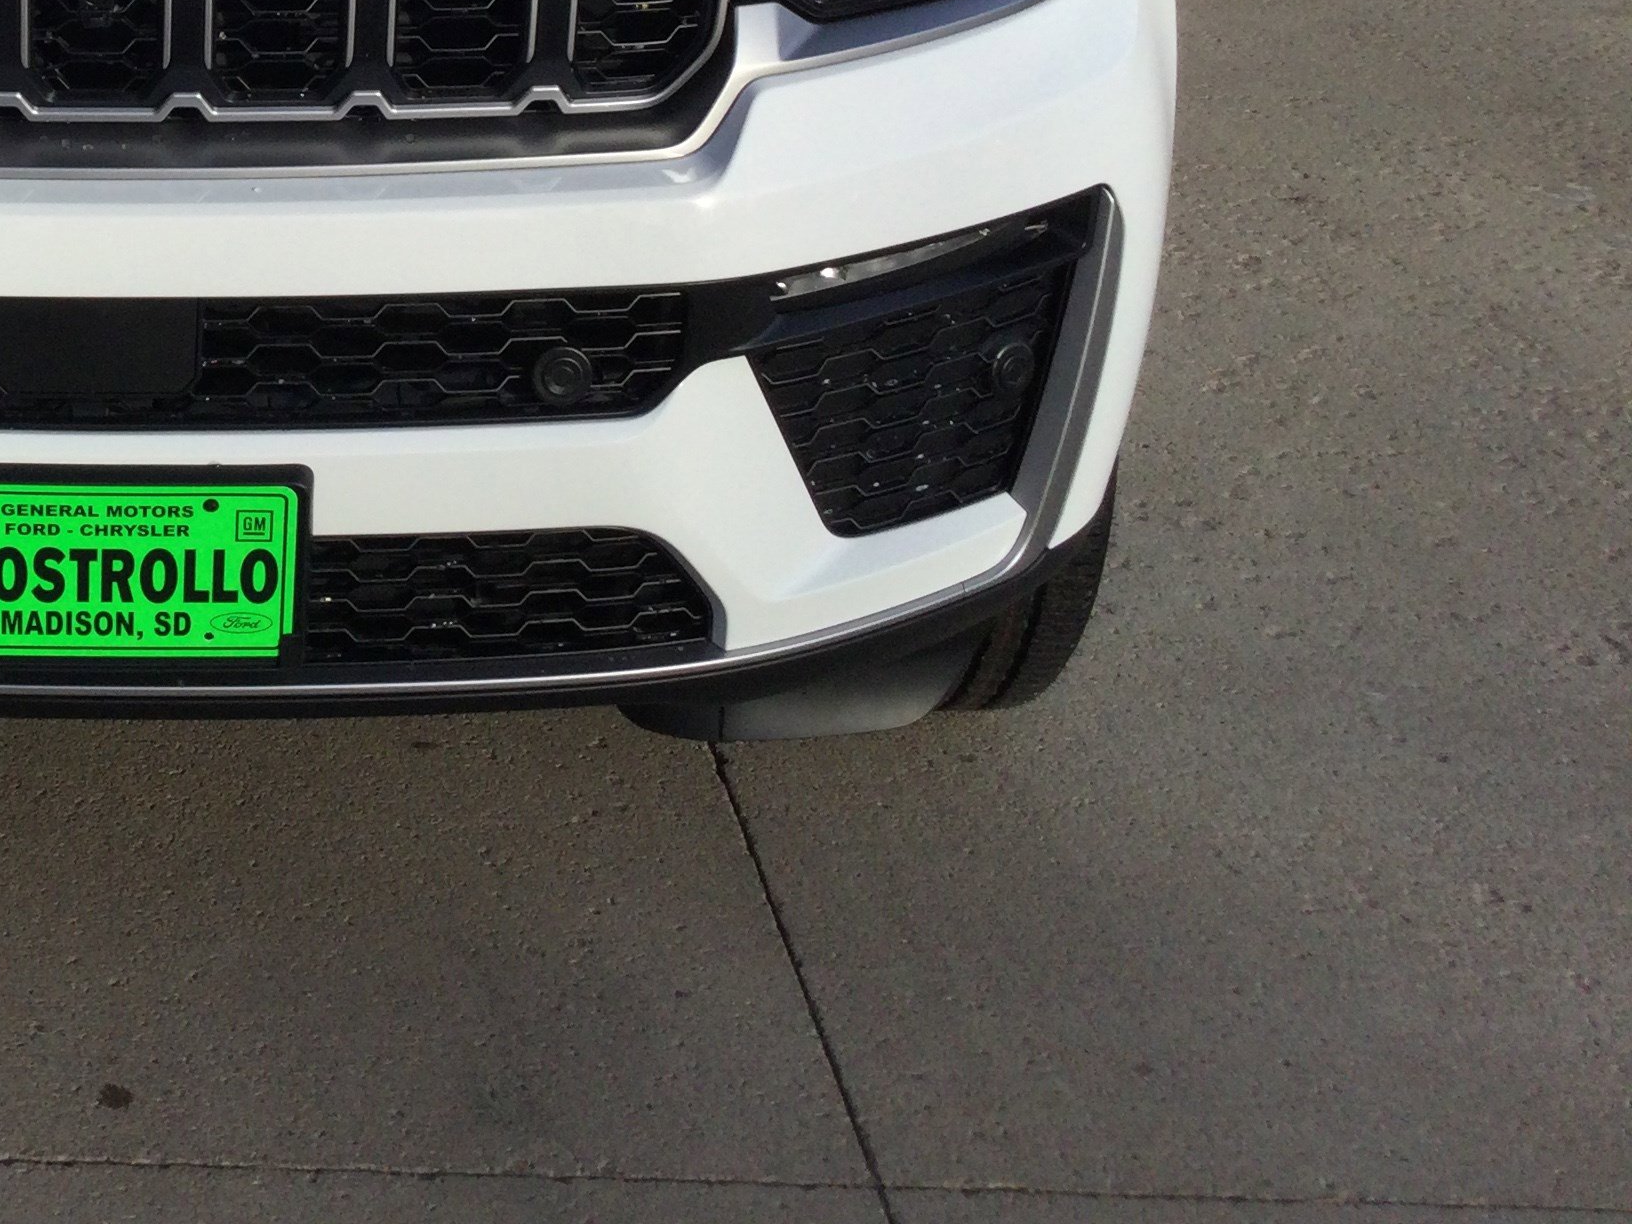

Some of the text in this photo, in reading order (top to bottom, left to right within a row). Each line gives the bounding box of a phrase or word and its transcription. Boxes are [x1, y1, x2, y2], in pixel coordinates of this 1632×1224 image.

[0, 503, 194, 519] GENERAL MOTORS
[5, 523, 61, 536] FORD
[79, 524, 190, 538] CHRYSLER
[243, 516, 266, 533] GM
[1, 610, 192, 640] MADISON, SD
[222, 613, 261, 631] Ford
